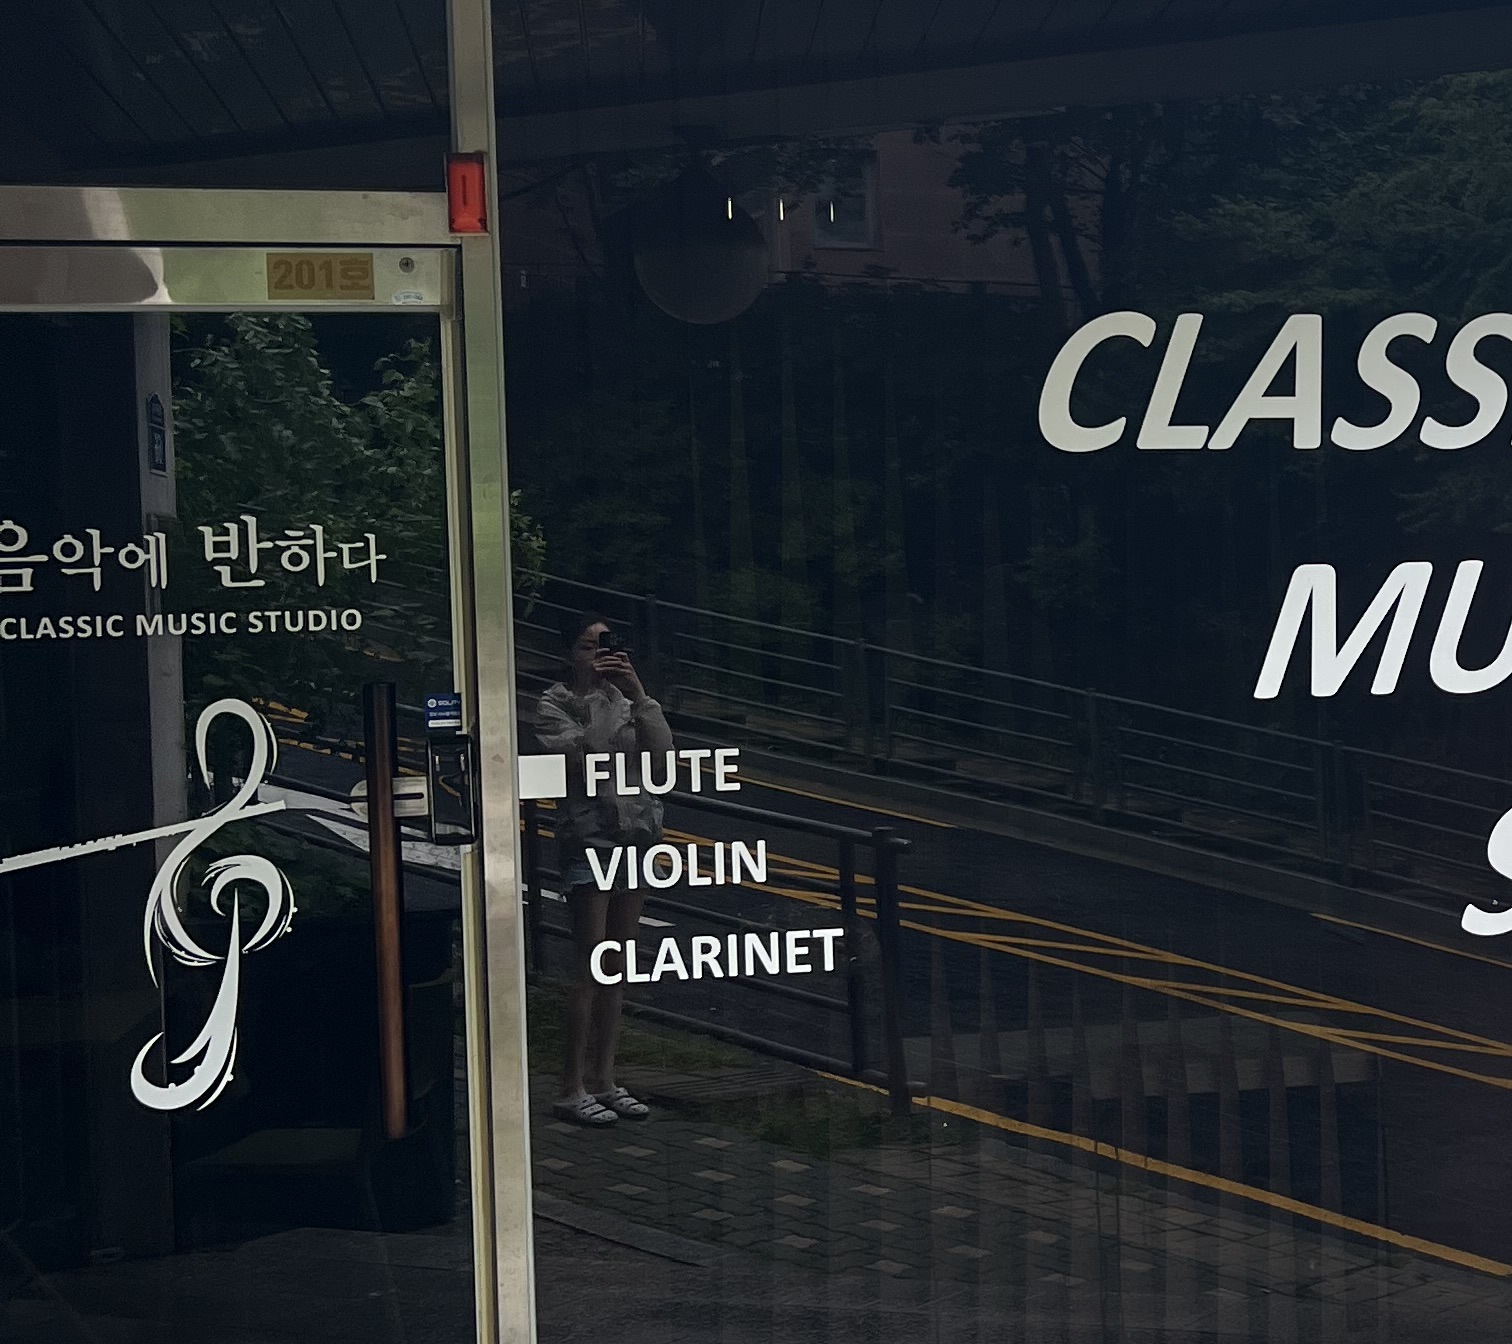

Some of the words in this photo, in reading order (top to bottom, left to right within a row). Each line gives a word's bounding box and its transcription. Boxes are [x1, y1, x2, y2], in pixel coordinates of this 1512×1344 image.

[272, 259, 372, 292] 201호
[0, 519, 169, 593] 음악에
[198, 515, 387, 587] 반하다
[0, 617, 125, 640] CLASSIC
[136, 612, 237, 636] MUSIC
[248, 608, 363, 633] STUDIO
[585, 748, 741, 797] FLUTE
[585, 839, 768, 891] VIOLIN
[590, 928, 844, 985] CLARINET
